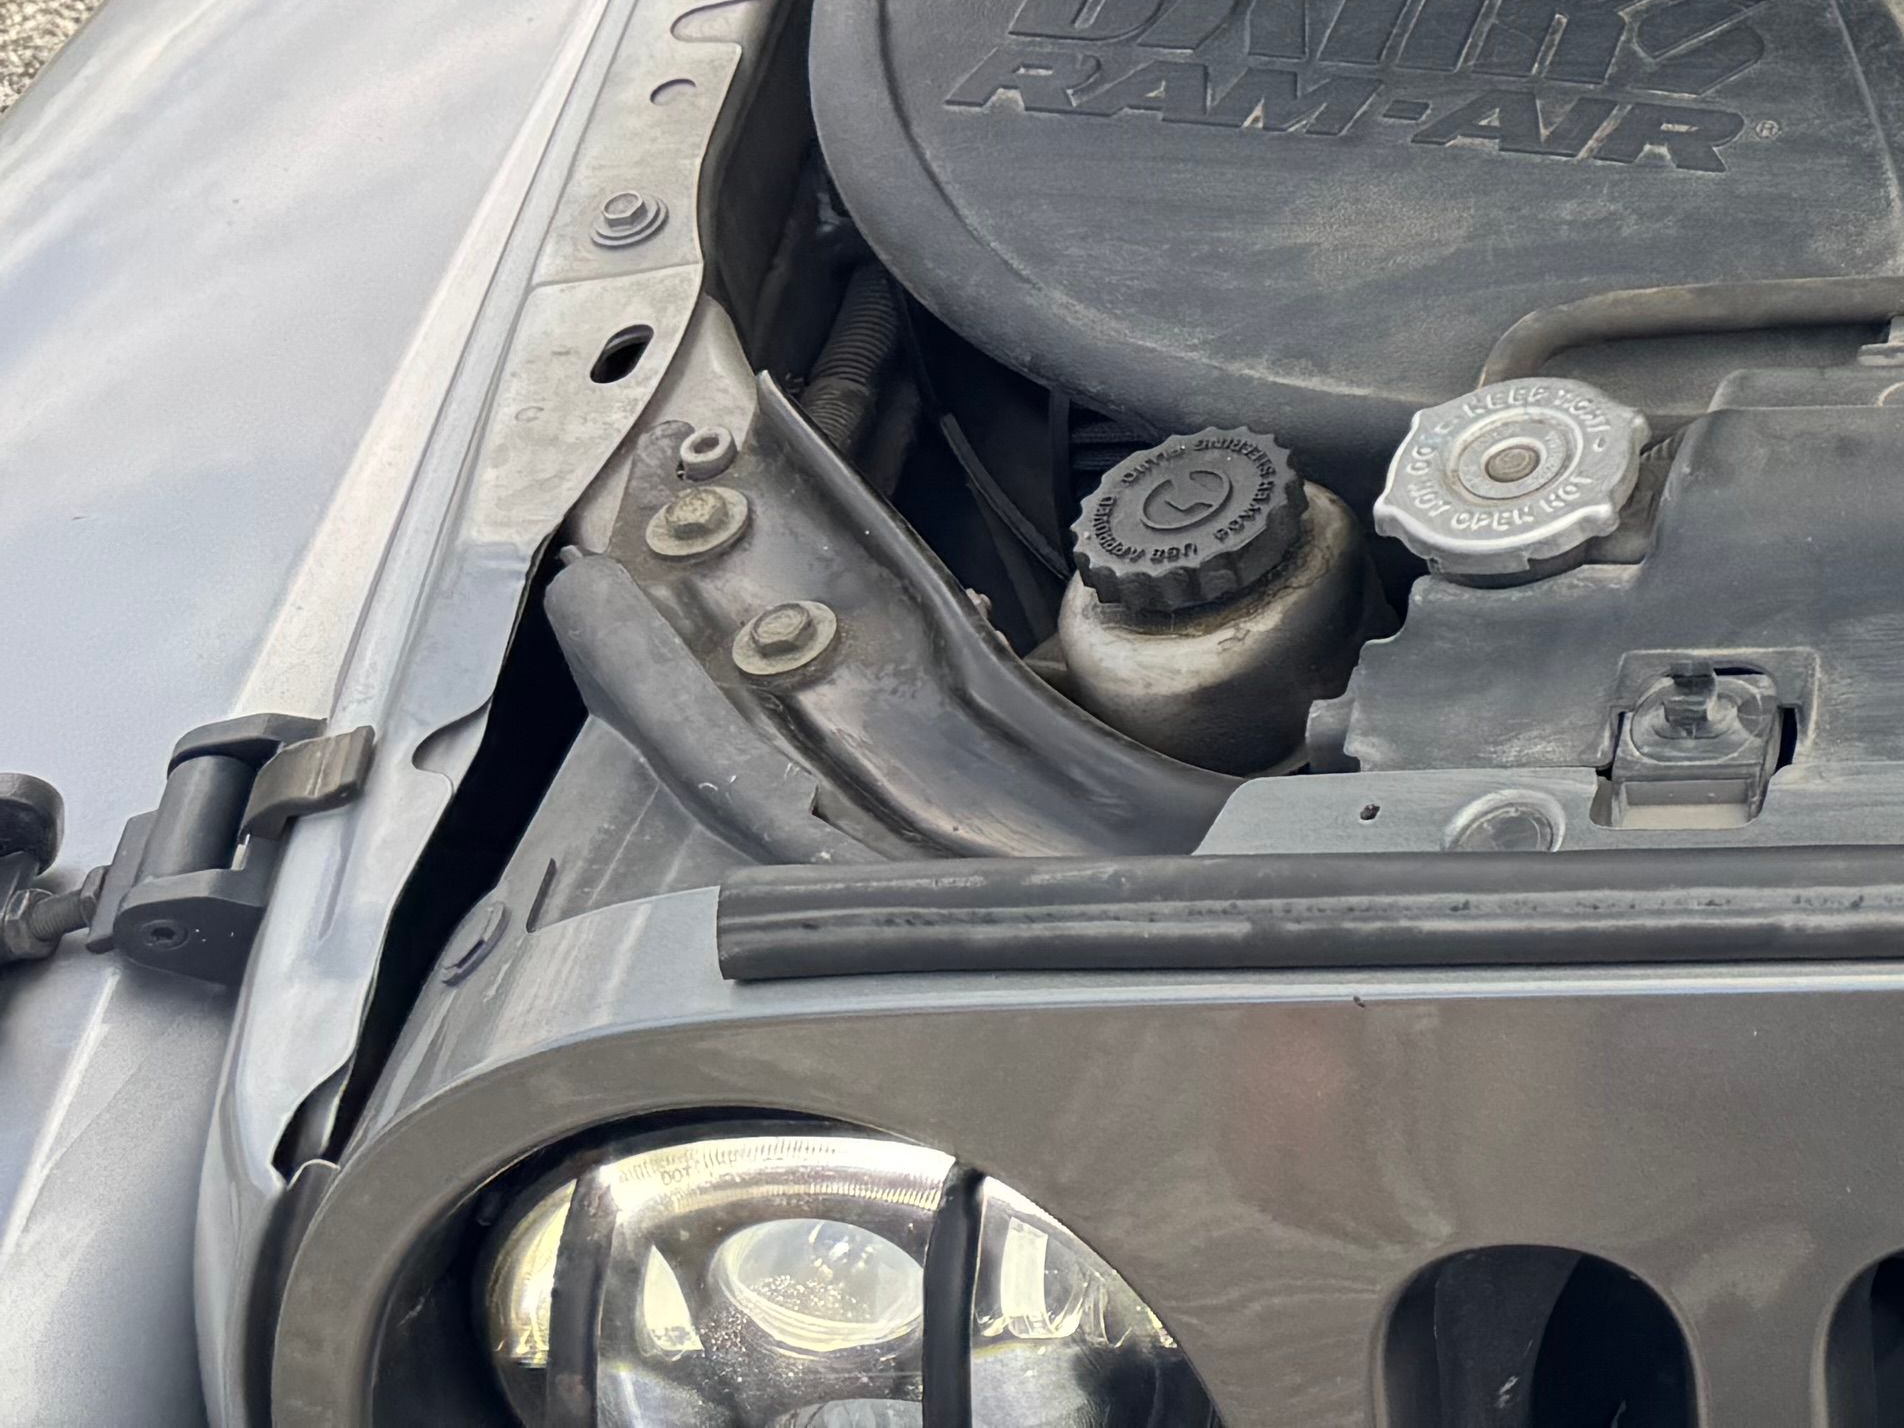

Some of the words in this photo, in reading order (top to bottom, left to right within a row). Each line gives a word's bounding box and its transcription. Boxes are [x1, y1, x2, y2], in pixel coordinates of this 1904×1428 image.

[1463, 385, 1551, 419] KEEP
[1450, 509, 1534, 531] OPEN
[660, 1167, 691, 1186] DOT
